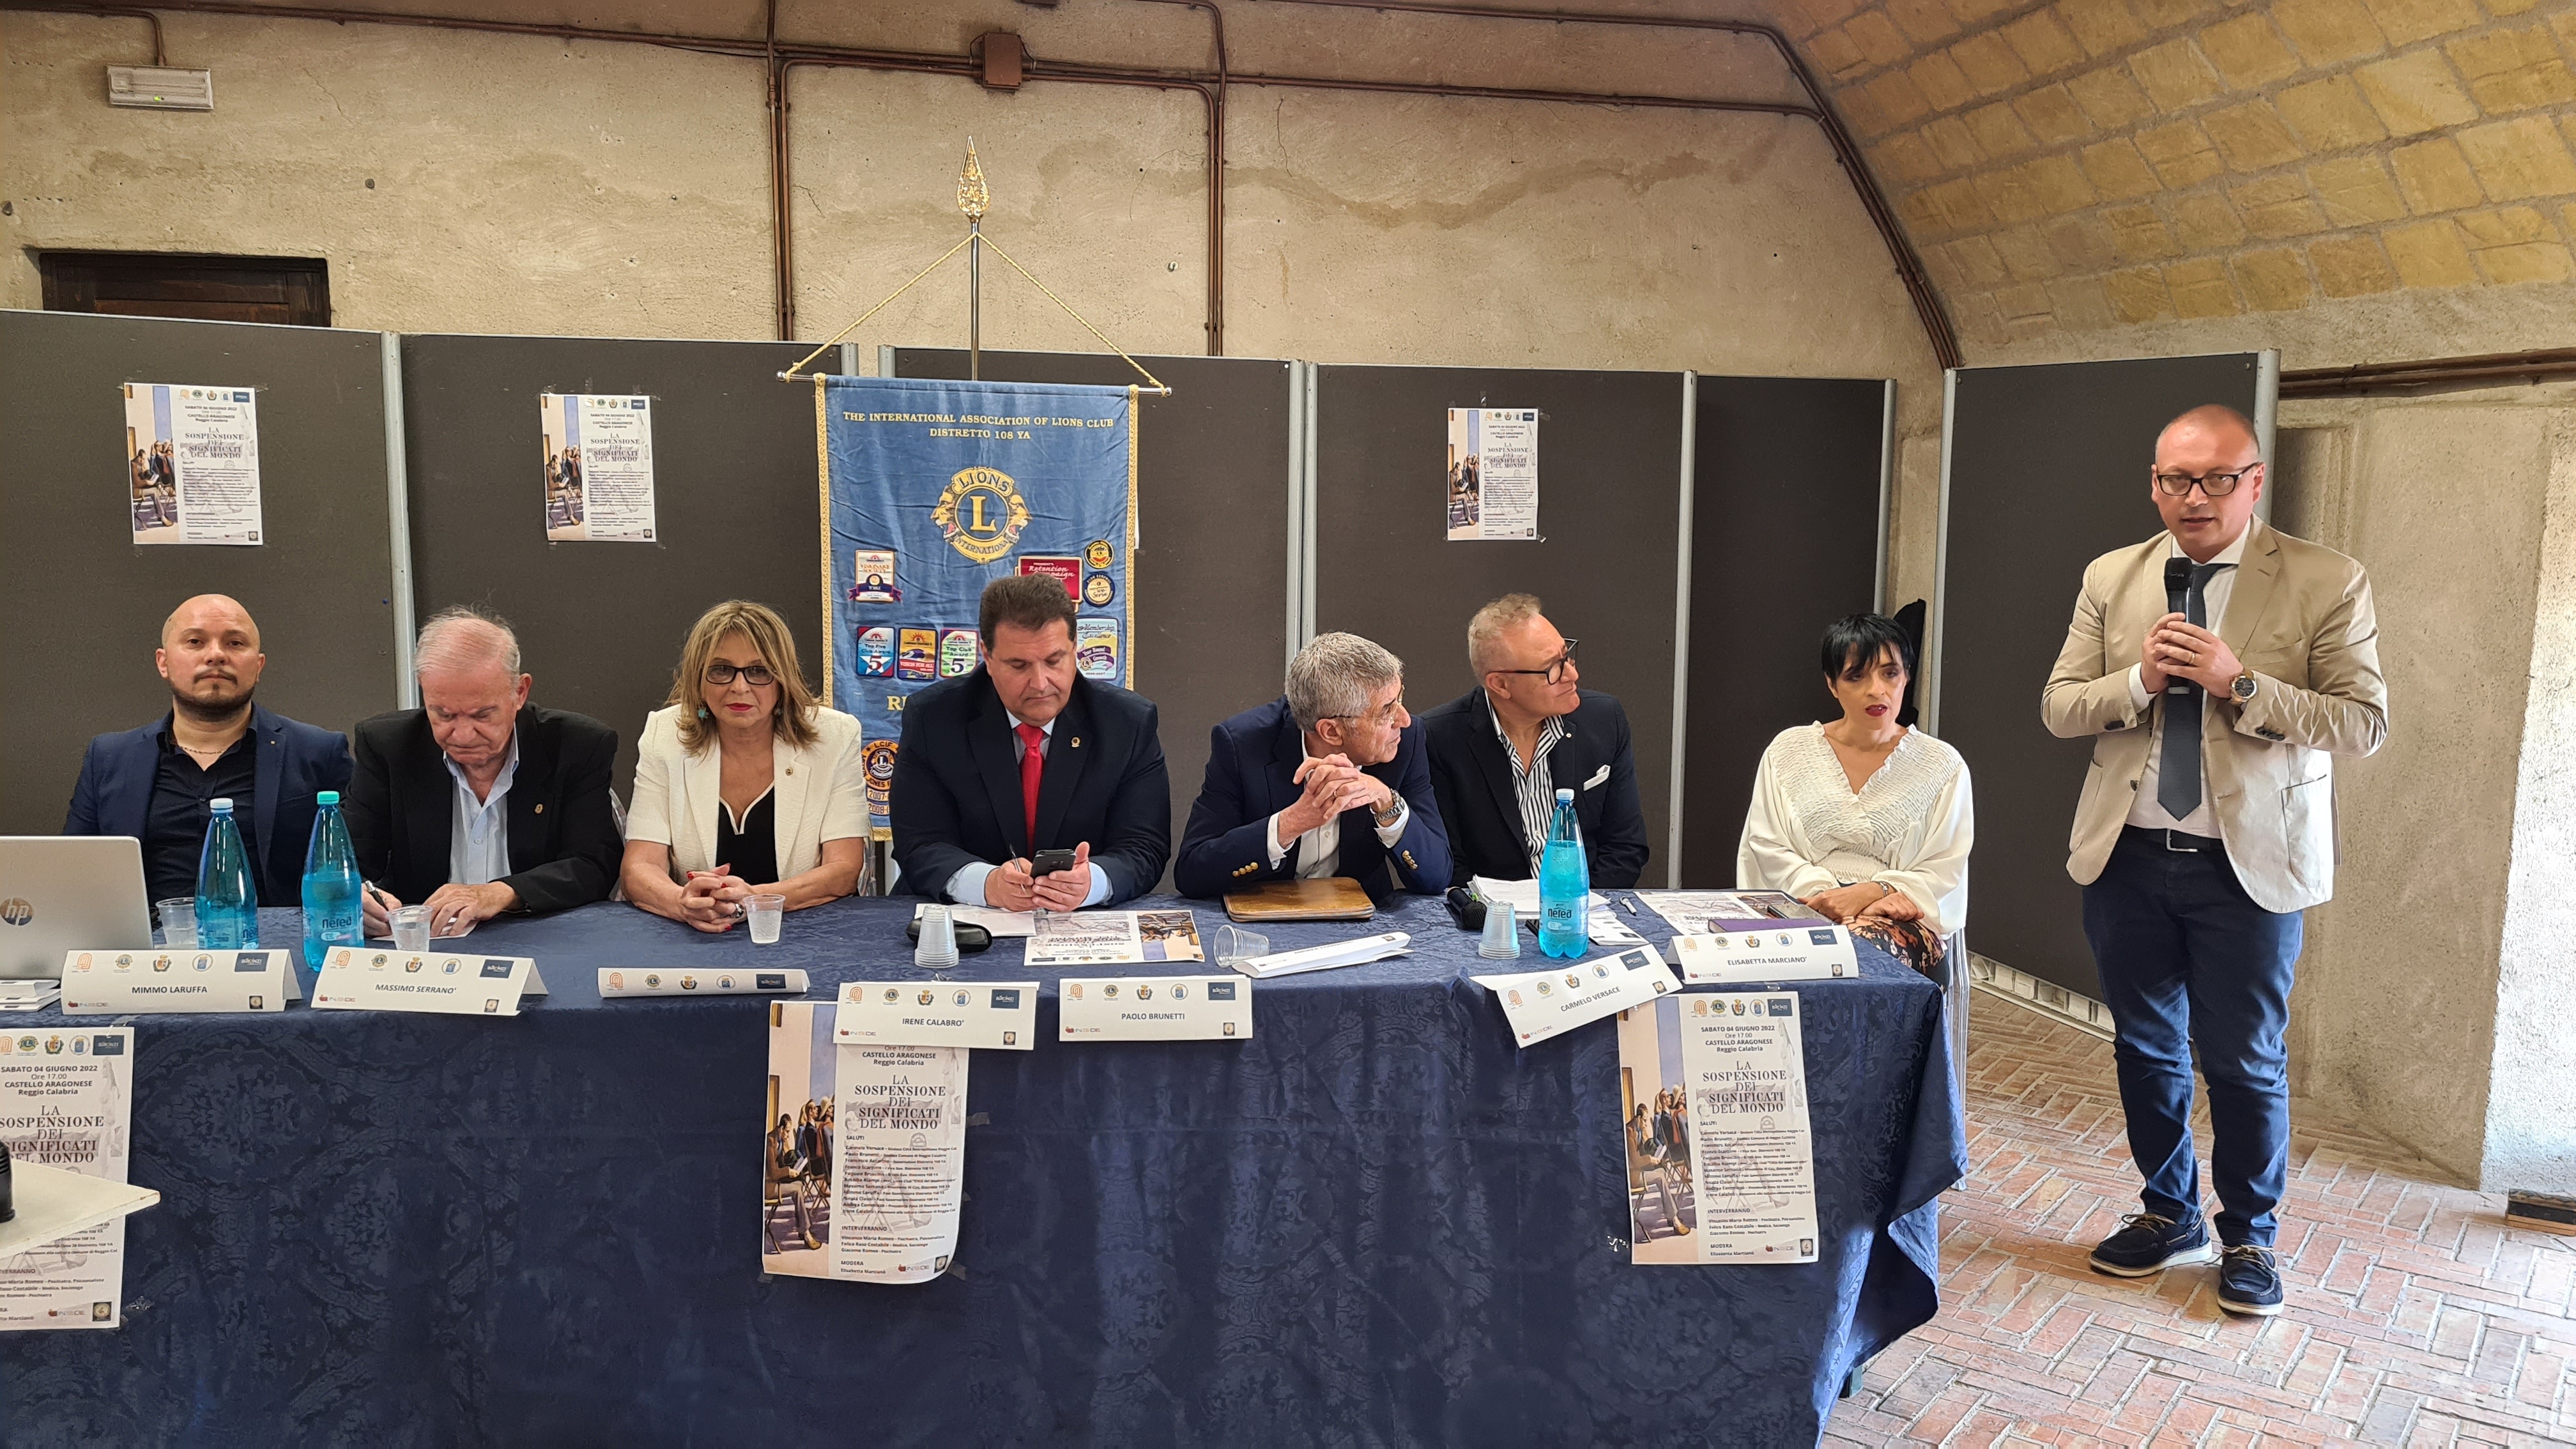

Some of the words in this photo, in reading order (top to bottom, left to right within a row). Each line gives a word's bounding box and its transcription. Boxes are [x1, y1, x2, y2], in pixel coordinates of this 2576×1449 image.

[843, 411, 866, 422] THE
[869, 413, 956, 423] INTERNATIONAL
[960, 415, 1030, 425] ASSOCIATION
[1034, 417, 1048, 426] OF
[1052, 417, 1084, 427] LIONS
[1087, 418, 1114, 428] CLUB
[930, 428, 990, 438] DISTRETTO
[995, 430, 1013, 440] 108
[1017, 431, 1031, 440] YA
[958, 471, 1009, 492] LIONS
[970, 496, 997, 532] L
[869, 656, 882, 670] 5
[951, 658, 965, 673] 5
[879, 756, 887, 765] L
[866, 778, 885, 788] JONES
[5, 898, 29, 926] hp
[1728, 958, 1767, 966] ELISABETTA
[375, 984, 415, 992] MASSIMO
[416, 986, 457, 994] SERRANO'
[1560, 997, 1592, 1013] CARMELO
[1592, 986, 1621, 1002] VERSACE
[926, 1018, 965, 1027] CALABRO'
[1736, 1061, 1752, 1071] LA
[893, 1075, 908, 1085] LA
[1703, 1070, 1787, 1082] SOSPENSIONE
[854, 1085, 946, 1096] SOSPENSIONE
[1735, 1082, 1756, 1092] DEI
[889, 1097, 911, 1107] DEI
[1708, 1092, 1784, 1103] SIGNIFICATI
[41, 1105, 61, 1116] LA
[859, 1107, 940, 1119] SIGNIFICATI
[1712, 1105, 1736, 1114] DEL
[1740, 1103, 1784, 1114] MONDO
[0, 1117, 105, 1128] SOSPENSIONE
[860, 1119, 887, 1130] DEL
[890, 1119, 938, 1130] MONDO
[37, 1129, 63, 1140] DEI
[39, 1152, 94, 1163] MONDO
